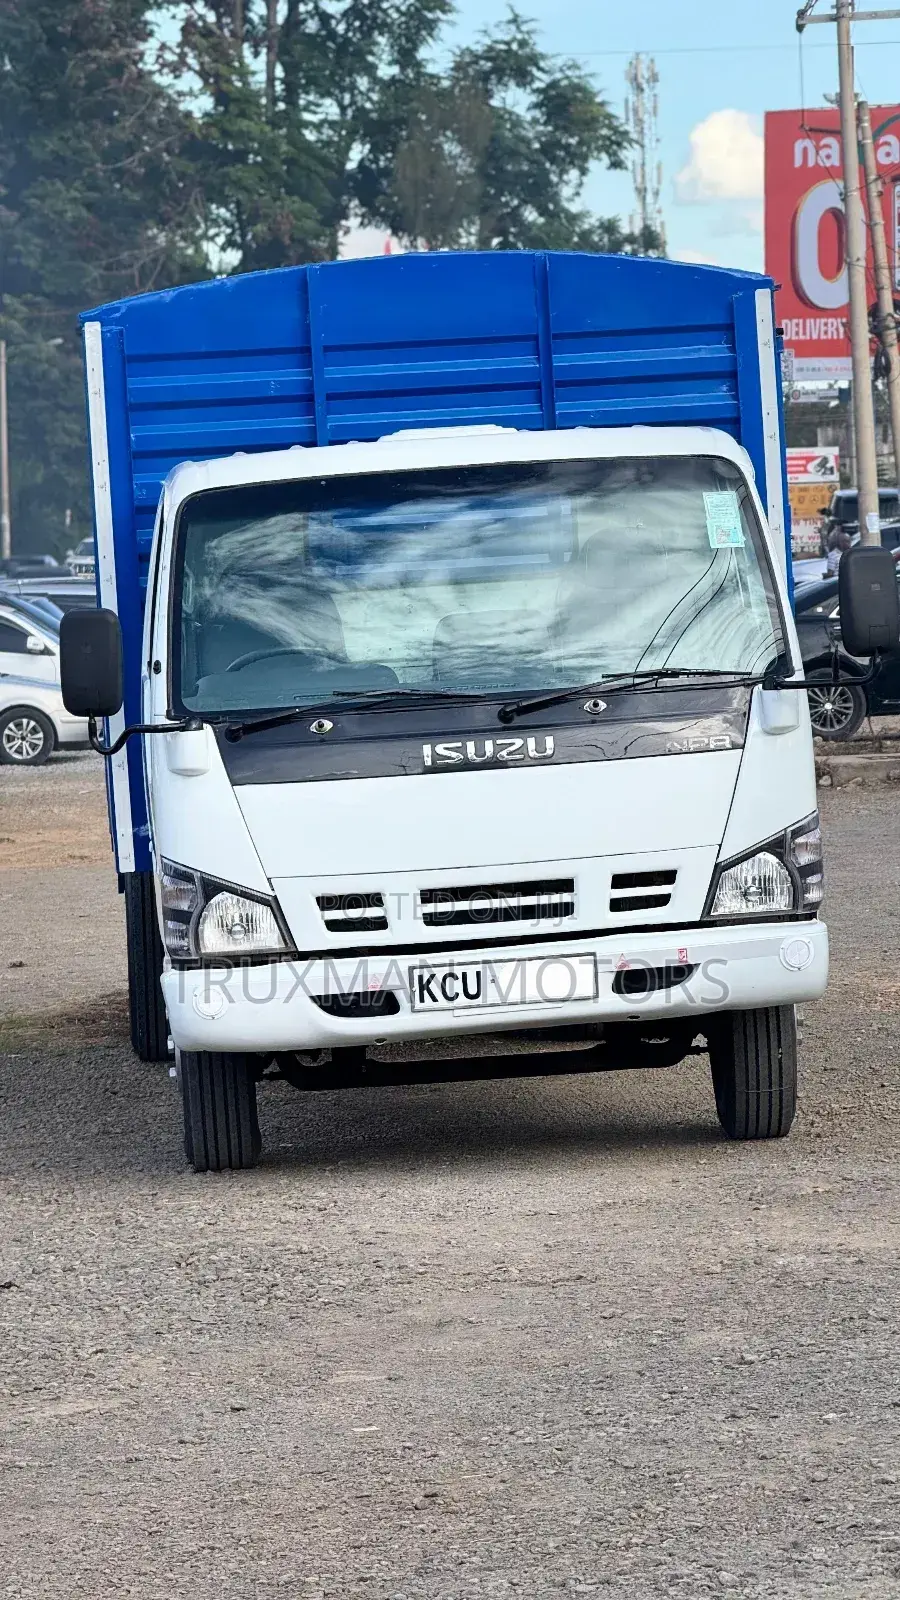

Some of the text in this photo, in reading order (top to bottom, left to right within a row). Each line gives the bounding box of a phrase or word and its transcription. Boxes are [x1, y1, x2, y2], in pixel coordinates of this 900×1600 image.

[781, 317, 847, 340] DELIVERY
[422, 735, 555, 766] ISUZU
[665, 735, 733, 752] NPR
[417, 970, 482, 1003] KCU
